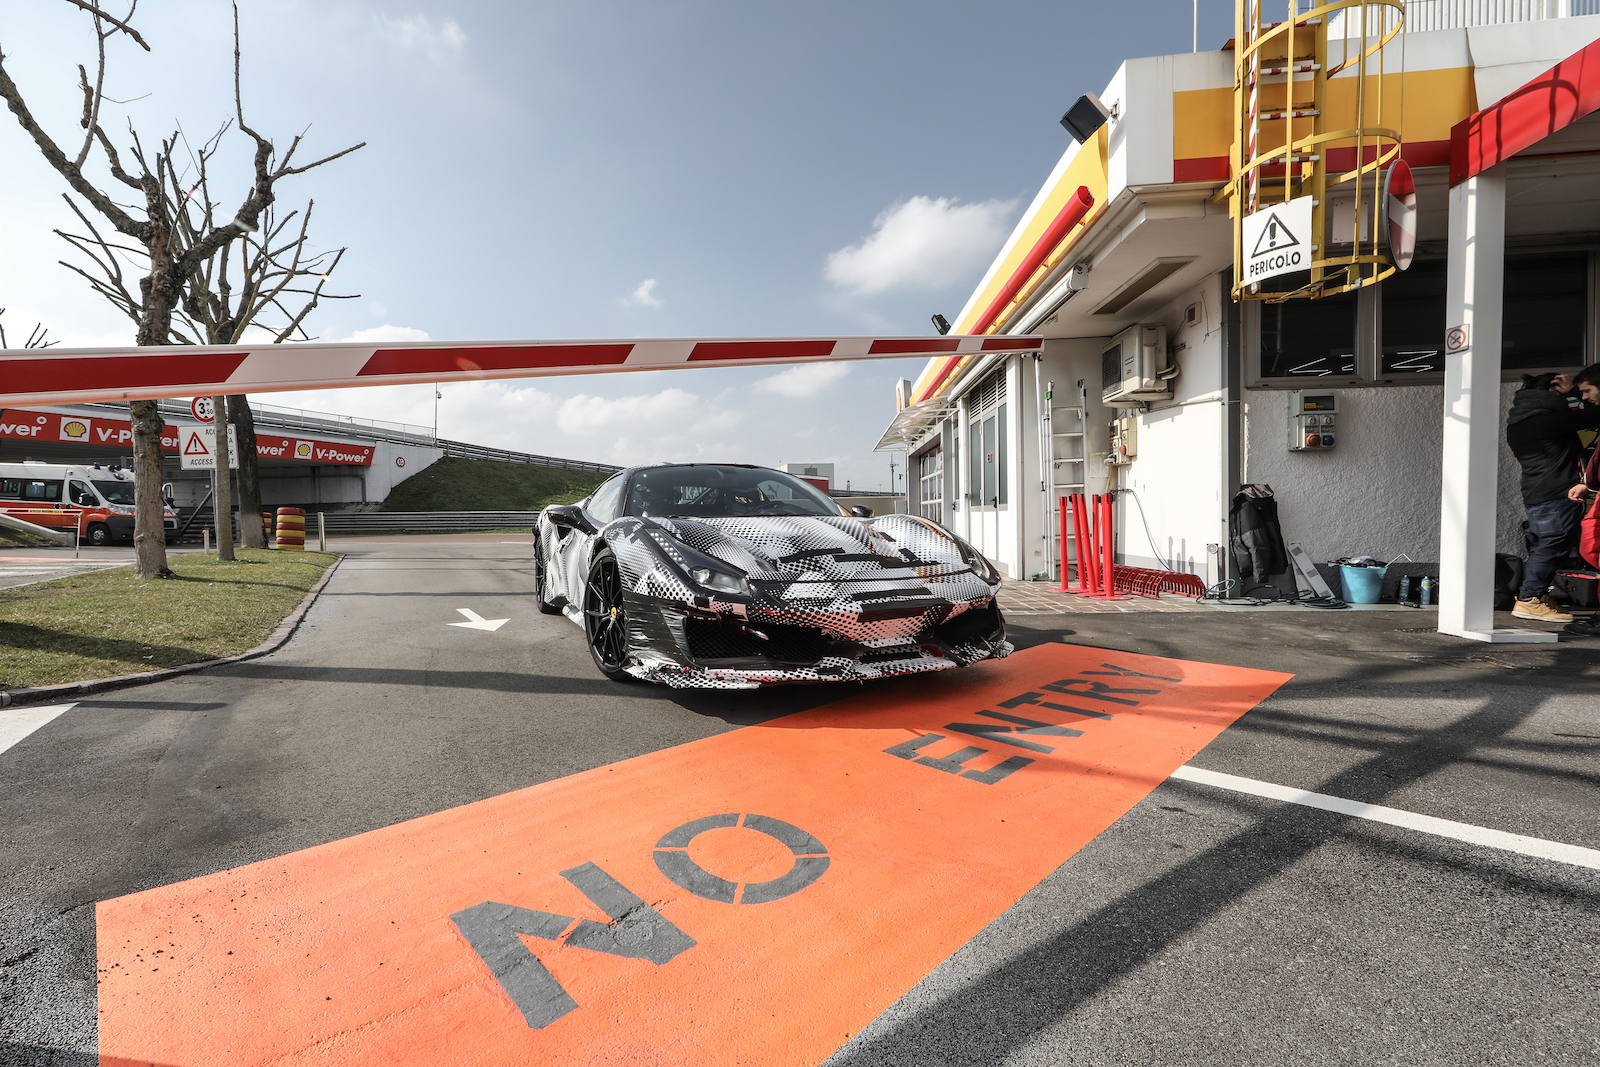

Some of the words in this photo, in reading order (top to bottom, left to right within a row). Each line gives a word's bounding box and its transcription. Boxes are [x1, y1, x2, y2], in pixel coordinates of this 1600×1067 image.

[1250, 251, 1301, 277] PERICOLO
[96, 427, 179, 447] V-Per
[190, 458, 213, 466] ACCESS
[316, 448, 366, 463] V-Power
[449, 812, 830, 1029] NO
[881, 663, 1182, 785] ENTRY
